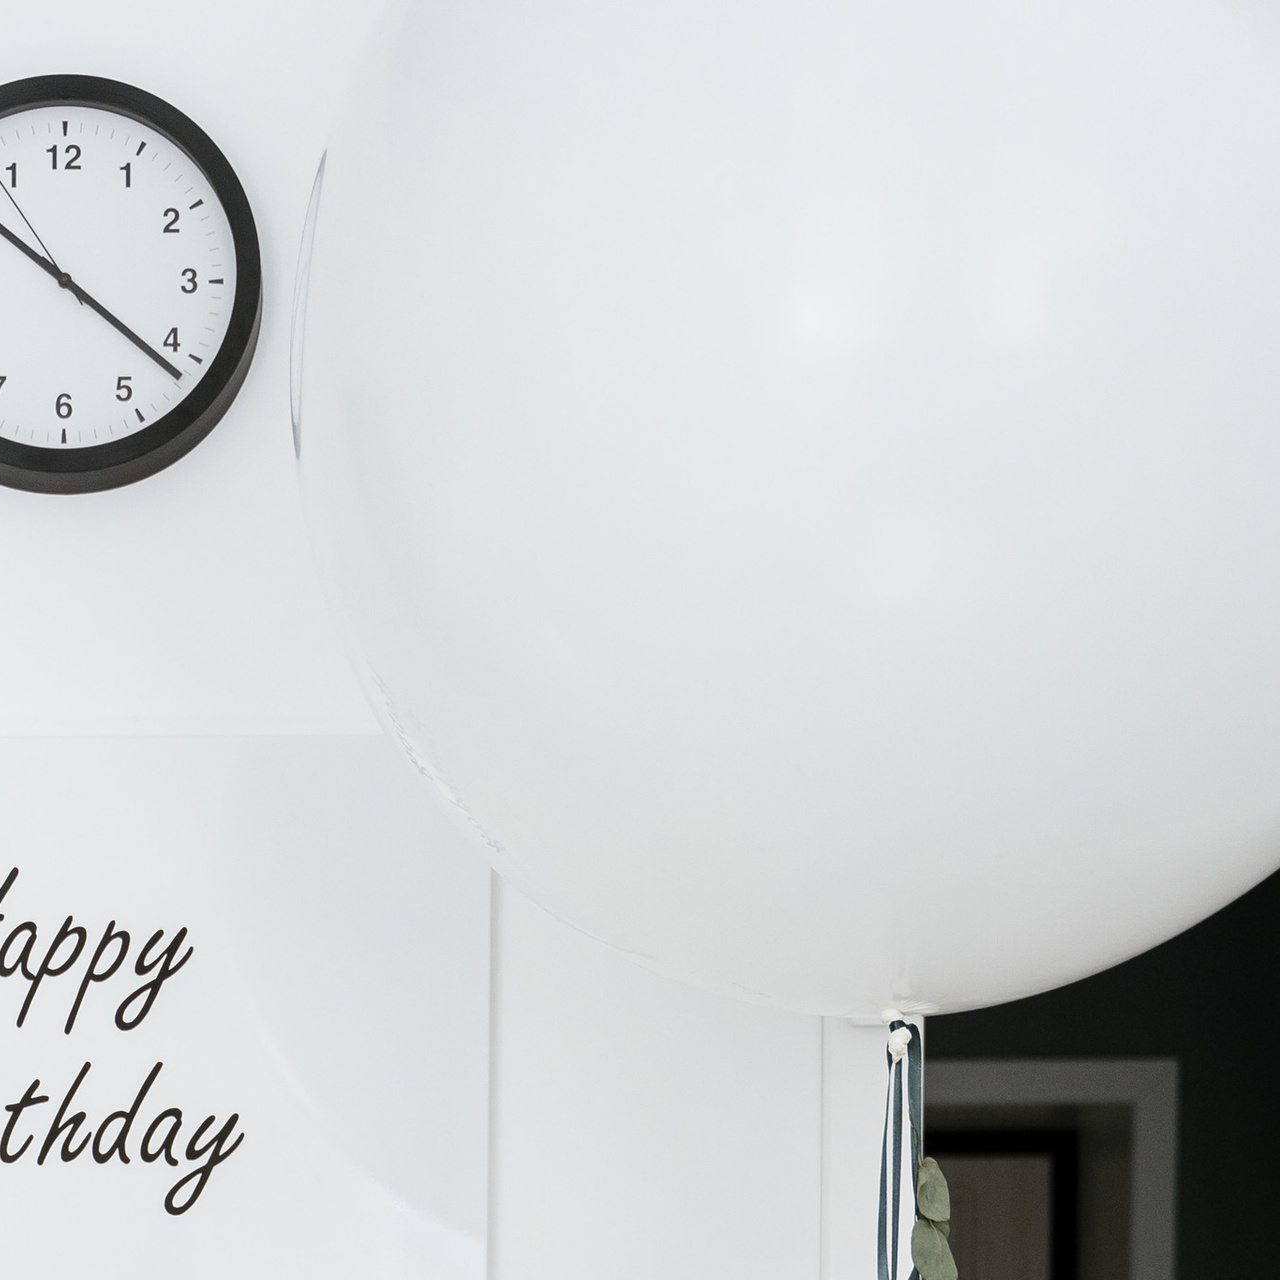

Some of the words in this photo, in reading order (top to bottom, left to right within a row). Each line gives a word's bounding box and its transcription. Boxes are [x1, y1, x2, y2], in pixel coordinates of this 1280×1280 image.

[46, 144, 82, 170] 12
[119, 162, 132, 188] 1
[162, 207, 180, 233] 2
[180, 267, 198, 294] 3
[162, 326, 181, 353] 4
[115, 376, 133, 402] 5
[55, 392, 73, 419] 6
